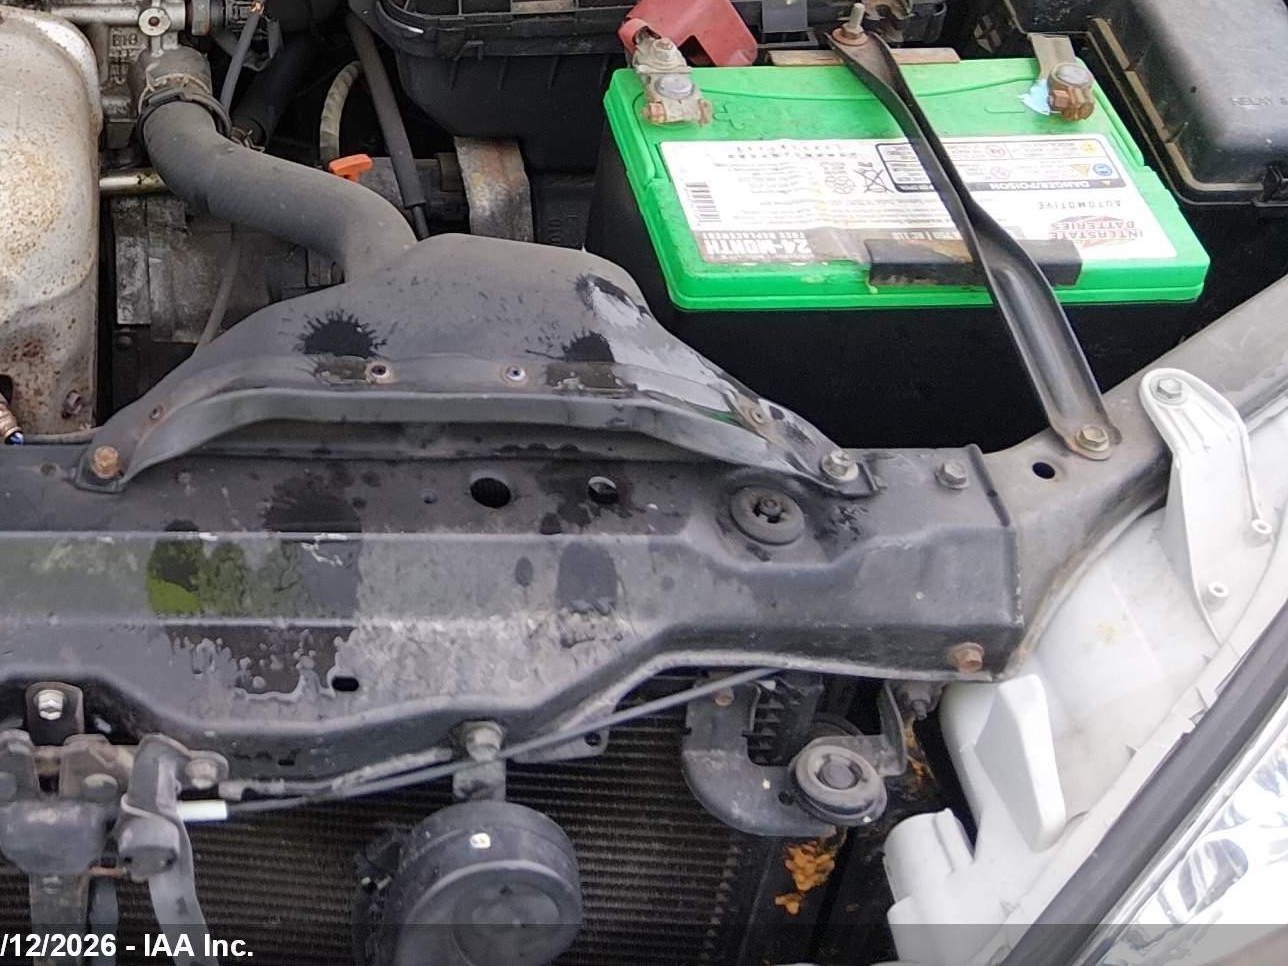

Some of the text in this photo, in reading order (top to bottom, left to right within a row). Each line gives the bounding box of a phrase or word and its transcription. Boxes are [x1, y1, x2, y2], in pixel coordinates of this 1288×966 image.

[1037, 199, 1122, 210] AUTOMOTIVE
[1050, 220, 1136, 231] BATTERIES
[701, 232, 777, 240] REPLACEMENT
[1049, 230, 1144, 241] INTERSTATE
[703, 239, 812, 255] 24-MONTH
